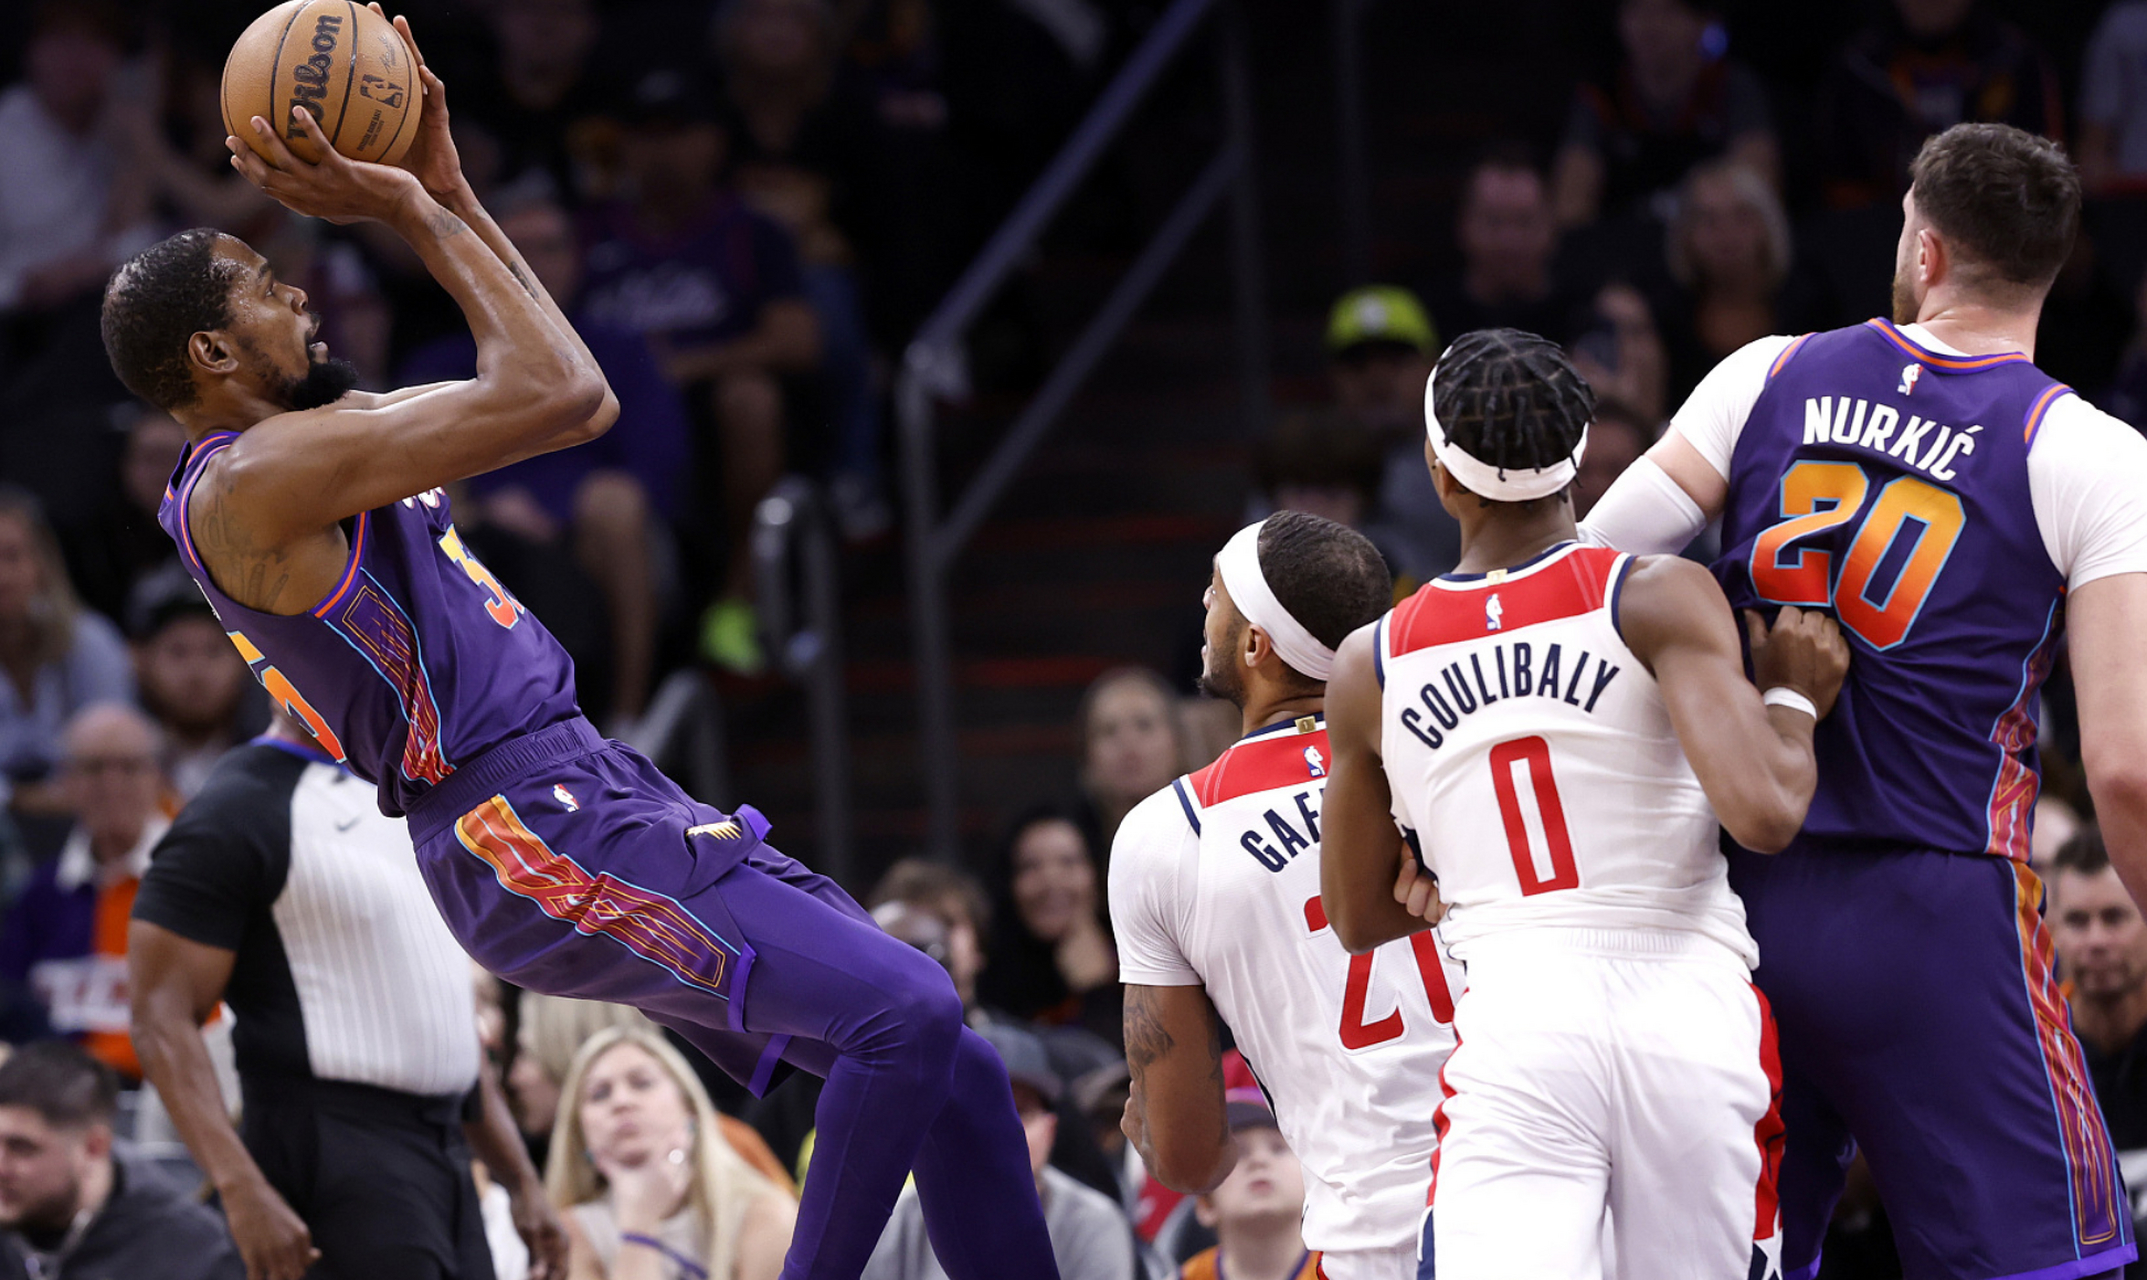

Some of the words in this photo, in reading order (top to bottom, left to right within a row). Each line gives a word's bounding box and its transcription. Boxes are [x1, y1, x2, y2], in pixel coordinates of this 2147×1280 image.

[286, 15, 343, 139] Wilson
[1803, 396, 1984, 481] NURKIĆ
[437, 523, 526, 630] 3
[1749, 459, 1966, 652] 20
[1401, 642, 1620, 750] COULIBALY
[1240, 788, 1325, 873] GAF
[1490, 735, 1579, 897] 0
